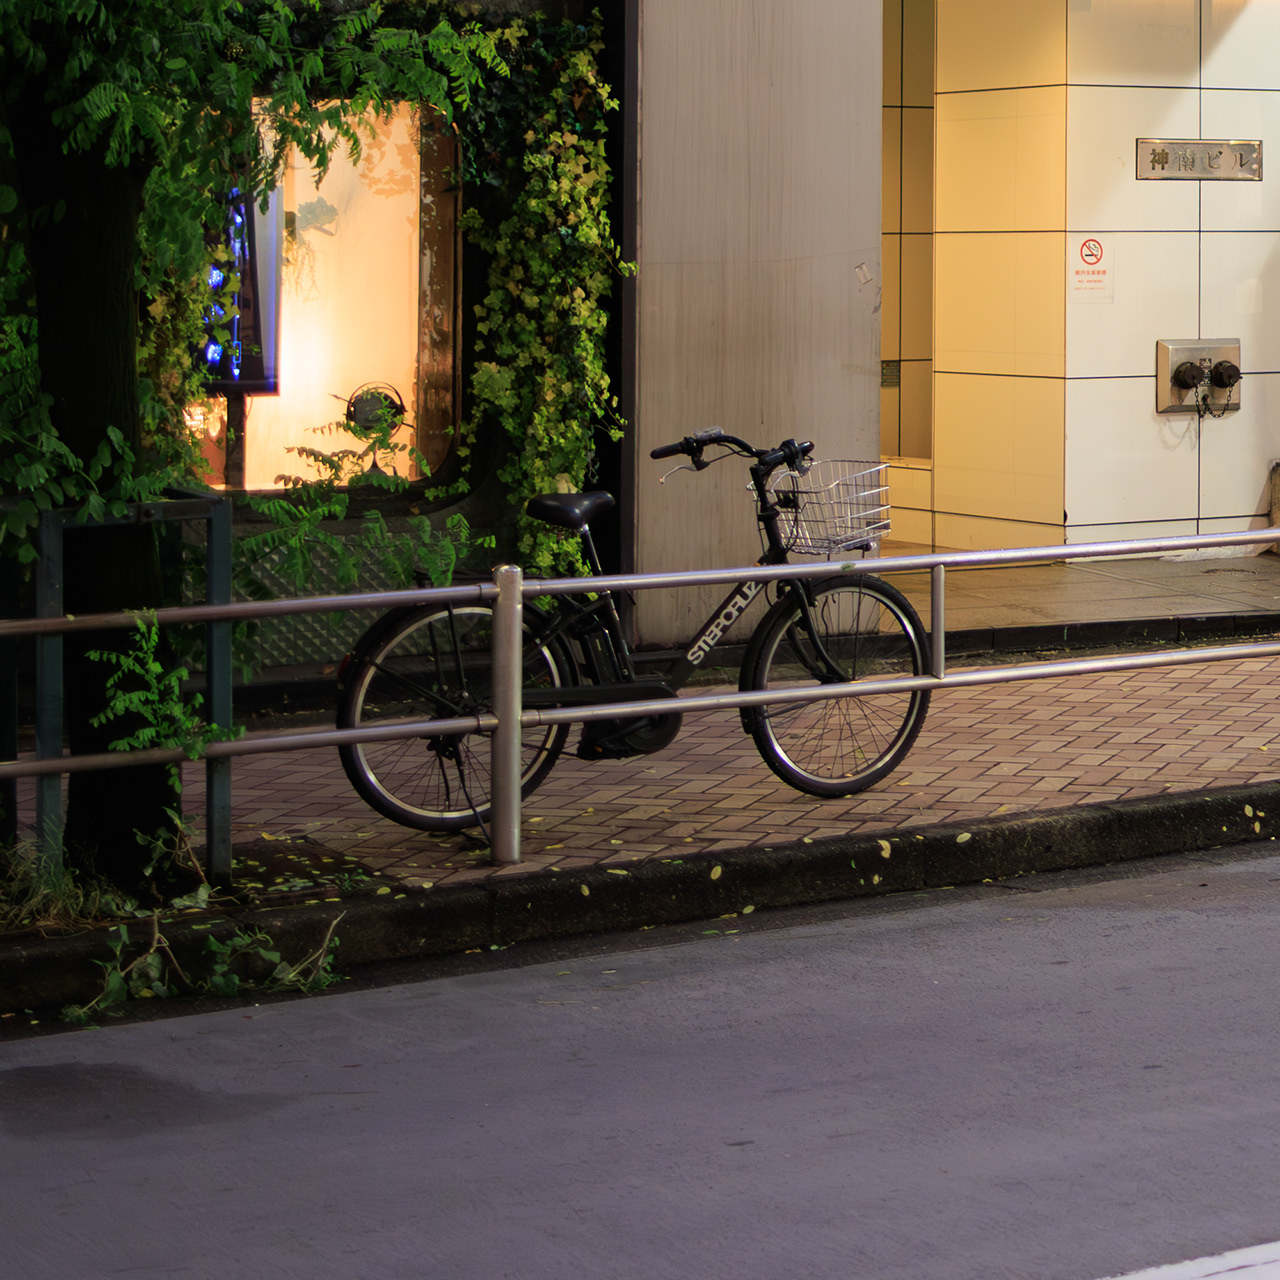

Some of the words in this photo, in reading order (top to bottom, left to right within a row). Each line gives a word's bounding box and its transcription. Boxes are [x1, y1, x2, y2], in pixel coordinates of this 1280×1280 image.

[1150, 148, 1250, 172] 神南ビル
[686, 581, 763, 665] STEPCRUZ
